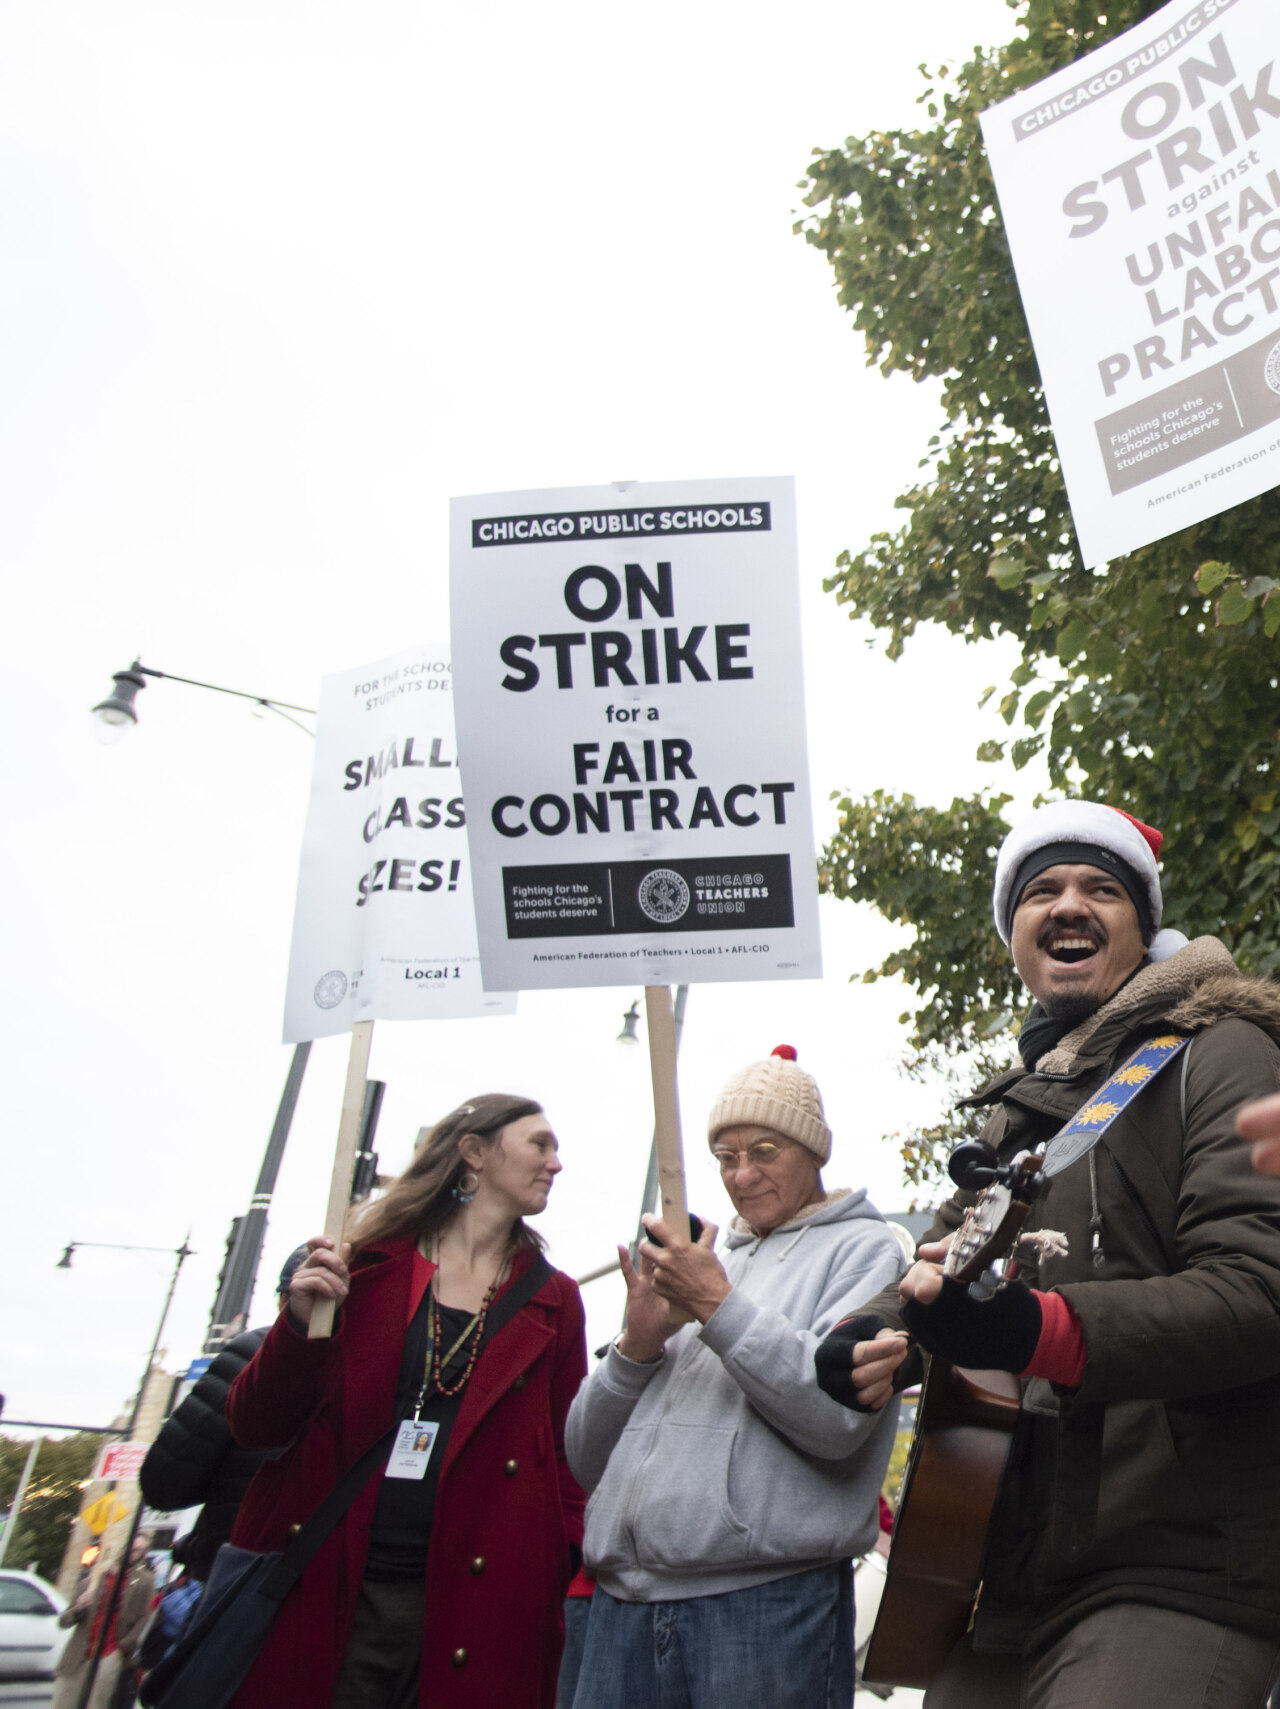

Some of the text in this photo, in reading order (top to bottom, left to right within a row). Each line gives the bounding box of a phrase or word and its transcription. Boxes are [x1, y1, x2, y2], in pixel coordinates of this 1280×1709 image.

[1021, 69, 1122, 132] CHICAGO
[1127, 15, 1201, 75] PUBLIC
[1121, 32, 1236, 140] ON
[1166, 150, 1260, 218] against
[1110, 397, 1204, 446] Fighting for the
[1113, 400, 1224, 458] schools Chicago's
[1116, 417, 1220, 471] students deserve
[1147, 480, 1201, 509] American
[1203, 448, 1267, 483] Federation
[1269, 438, 1280, 452] of
[478, 507, 763, 541] CHICAGO PUBLIC SCHOOLS
[564, 561, 675, 623] ON
[500, 623, 754, 693] STRIKE
[354, 680, 379, 696] FOR
[427, 679, 454, 691] DE
[605, 704, 660, 723] for a
[343, 737, 459, 791] SMALL
[573, 738, 698, 786] FAIR
[362, 796, 467, 844] CLASS
[491, 782, 796, 839] CONTRACT
[356, 858, 461, 907] SZES!
[513, 883, 589, 897] Fighting for the
[513, 894, 602, 908] schools Chicago's
[695, 873, 765, 887] CHICAGO
[696, 887, 769, 900] TEACHERS
[514, 907, 598, 920] students deserve
[697, 901, 746, 914] UNION
[404, 967, 462, 980] Local 1
[532, 951, 576, 962] American
[578, 949, 628, 960] Federation
[629, 949, 640, 958] of
[642, 947, 682, 957] Teachers
[690, 946, 716, 956] Local
[731, 944, 770, 954] AFL-CIO
